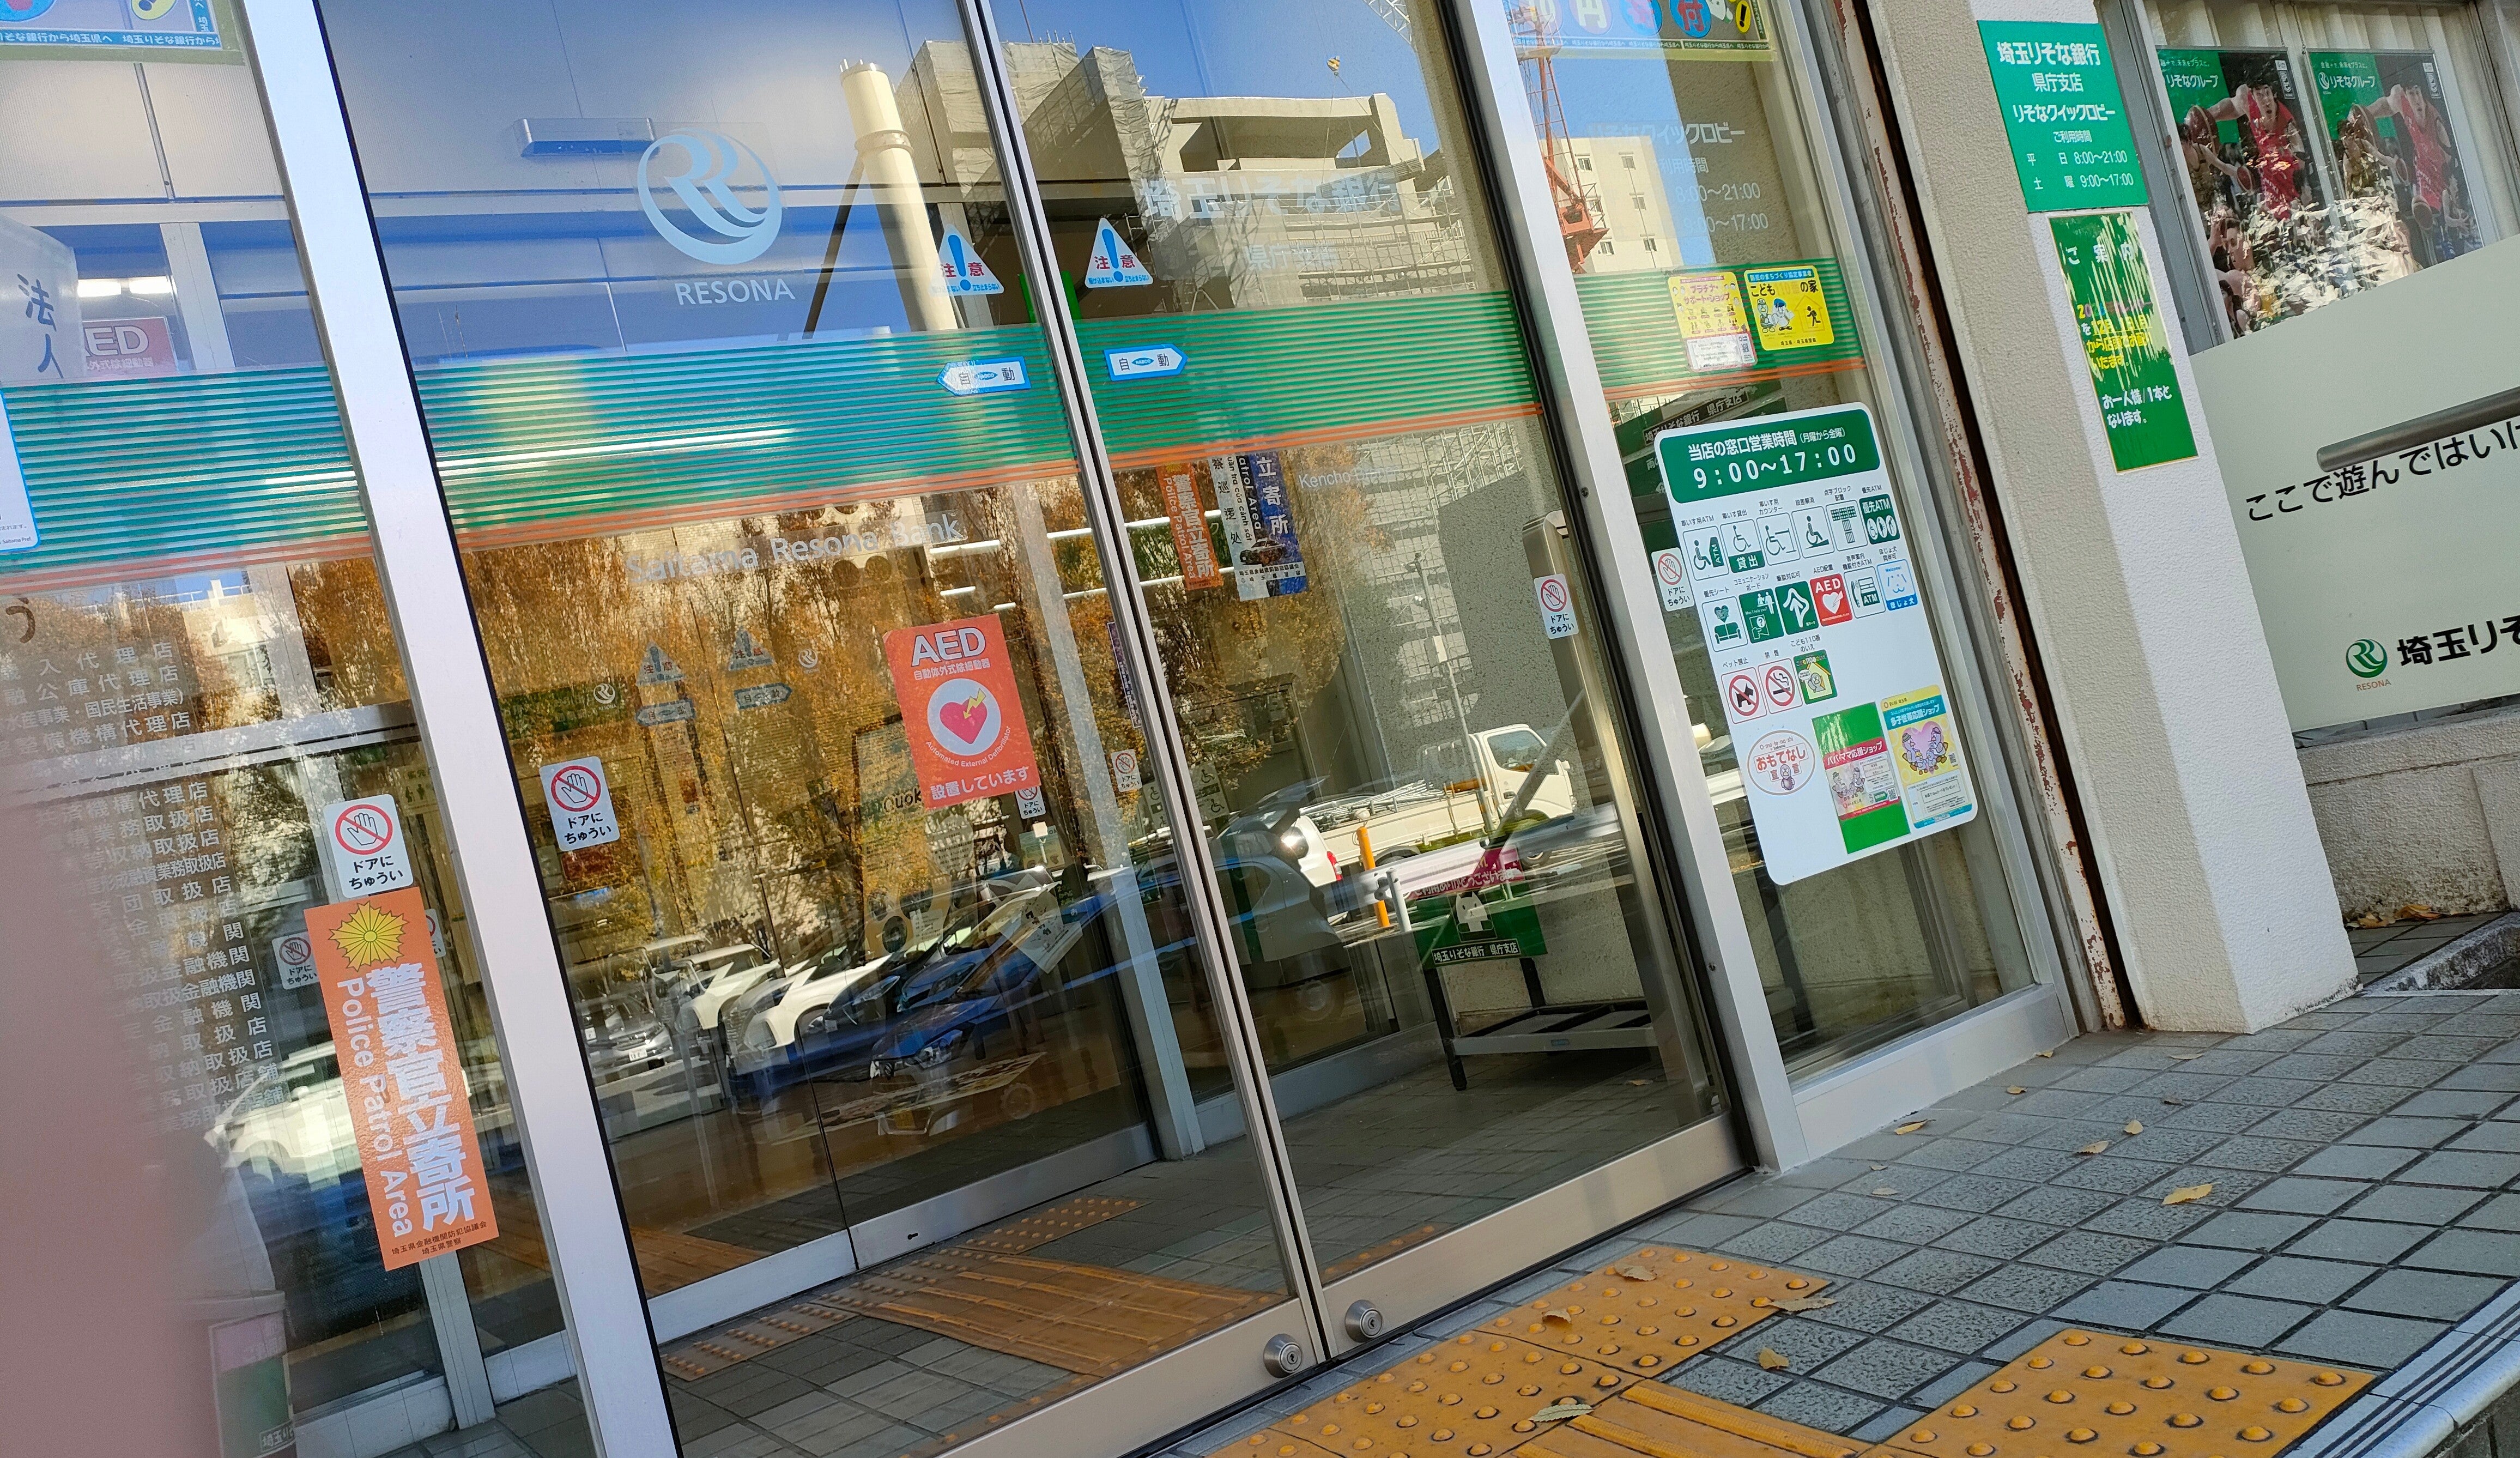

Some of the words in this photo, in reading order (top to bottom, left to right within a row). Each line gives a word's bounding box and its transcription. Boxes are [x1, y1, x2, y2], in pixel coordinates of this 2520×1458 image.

[1997, 41, 2100, 65] 埼玉りそな銀行
[2032, 72, 2083, 92] 県庁支店
[2166, 74, 2219, 88] りそなグループ
[2330, 75, 2376, 88] りそなグループ
[2013, 104, 2115, 123] りそなクイックロビー
[2053, 130, 2092, 143] ご利用時間
[1654, 157, 1709, 173] 利用時間
[1141, 173, 1401, 218] 埼玉りそな銀行
[674, 278, 796, 306] RESONA
[83, 325, 149, 357] ED
[2107, 410, 2147, 429] なります。
[1688, 429, 1797, 462] 当店の窓口営業時間
[1299, 470, 1352, 489] Kencho
[1238, 457, 1254, 489] atrol
[1248, 497, 1262, 530] Area
[1256, 456, 1289, 535] 立寄所
[1824, 485, 1852, 496] 点字ブロック
[1862, 485, 1882, 494] 優先ATM
[1758, 505, 1784, 515] カウンター
[1759, 498, 1779, 507] 車いす用
[1862, 498, 1892, 515] 優先ATM
[1681, 514, 1715, 527] 車いす用ATM
[1722, 509, 1748, 520] 車いす貸出
[1164, 477, 1178, 513] Police
[1174, 516, 1186, 549] Patrol
[1183, 553, 1196, 579] Area
[1172, 474, 1215, 579] 警察官立寄所
[626, 547, 759, 583] Saitama
[769, 530, 879, 565] Resona
[891, 513, 964, 546] Bank
[1713, 544, 1722, 564] ATM
[1879, 546, 1898, 555] ほじょ犬
[1736, 554, 1759, 570] 貸出
[1813, 564, 1834, 574] AED配置
[1734, 573, 1769, 586] コミュニケーション
[1746, 583, 1761, 591] ボード
[1815, 578, 1842, 594] AED
[1668, 586, 1685, 596] ドアに
[1704, 586, 1730, 598] 優先シート
[1863, 594, 1877, 604] ATM
[1667, 595, 1690, 607] ちゅうい
[1890, 597, 1916, 609] ほじょ犬
[1550, 613, 1570, 625] ドアに
[1549, 623, 1574, 635] ちゅうい
[911, 627, 986, 668] AED
[1790, 634, 1821, 648] こども110番
[1800, 644, 1815, 653] のいえ
[1764, 649, 1780, 660] 禁煙
[913, 658, 991, 681] 自動体外式除細動器
[1723, 657, 1749, 669] ペット禁止
[2357, 679, 2392, 692] RESONA
[925, 740, 960, 767] Automated
[961, 757, 988, 768] External
[987, 725, 1012, 761] Defibrillator
[1756, 746, 1806, 771] おもてなし
[930, 766, 1029, 801] 設置しています
[1022, 806, 1043, 815] ちゅうい
[1023, 800, 1039, 808] ドアに
[568, 812, 603, 830] ドアに
[564, 826, 612, 845] ちゅうい
[353, 855, 394, 873] ドアに
[349, 868, 403, 891] ちゅうい
[1433, 945, 1485, 963] 埼玉りそな銀行
[1490, 942, 1518, 955] 県庁支店
[289, 964, 312, 975] ドアに
[286, 973, 317, 985] ちゅうい
[365, 963, 475, 1232] 警察官立寄所
[337, 977, 374, 1067] Police
[360, 1073, 395, 1162] Patrol
[378, 1168, 413, 1237] Area
[391, 1220, 487, 1255] 埼玉県金融機関防犯協議会
[421, 1237, 462, 1255] 埼玉県警察
